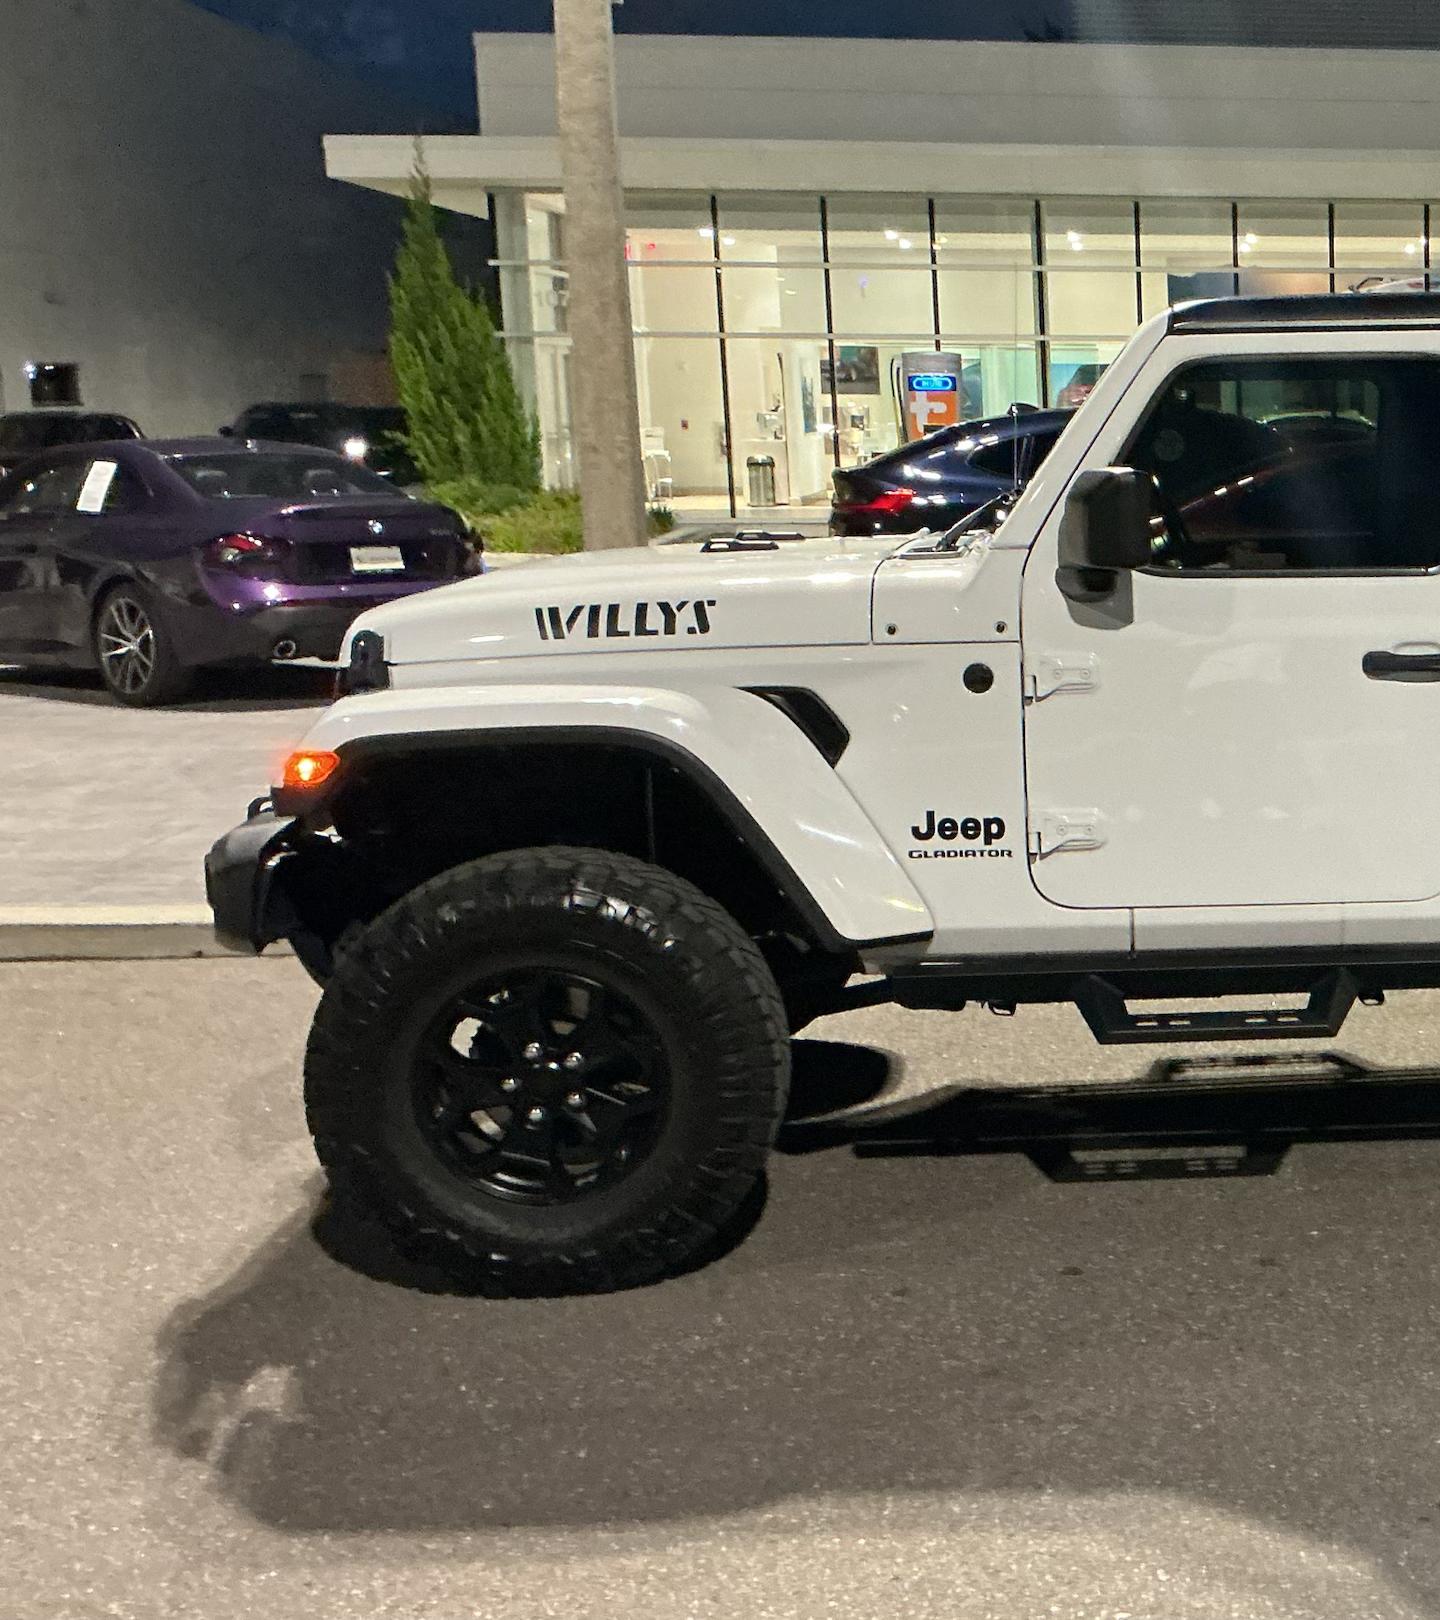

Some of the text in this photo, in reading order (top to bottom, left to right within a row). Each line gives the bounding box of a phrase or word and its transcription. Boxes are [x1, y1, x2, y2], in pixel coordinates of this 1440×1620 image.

[535, 599, 717, 641] WILLYS
[911, 810, 1006, 845] Jeep
[908, 849, 1013, 859] GLADIATOR
